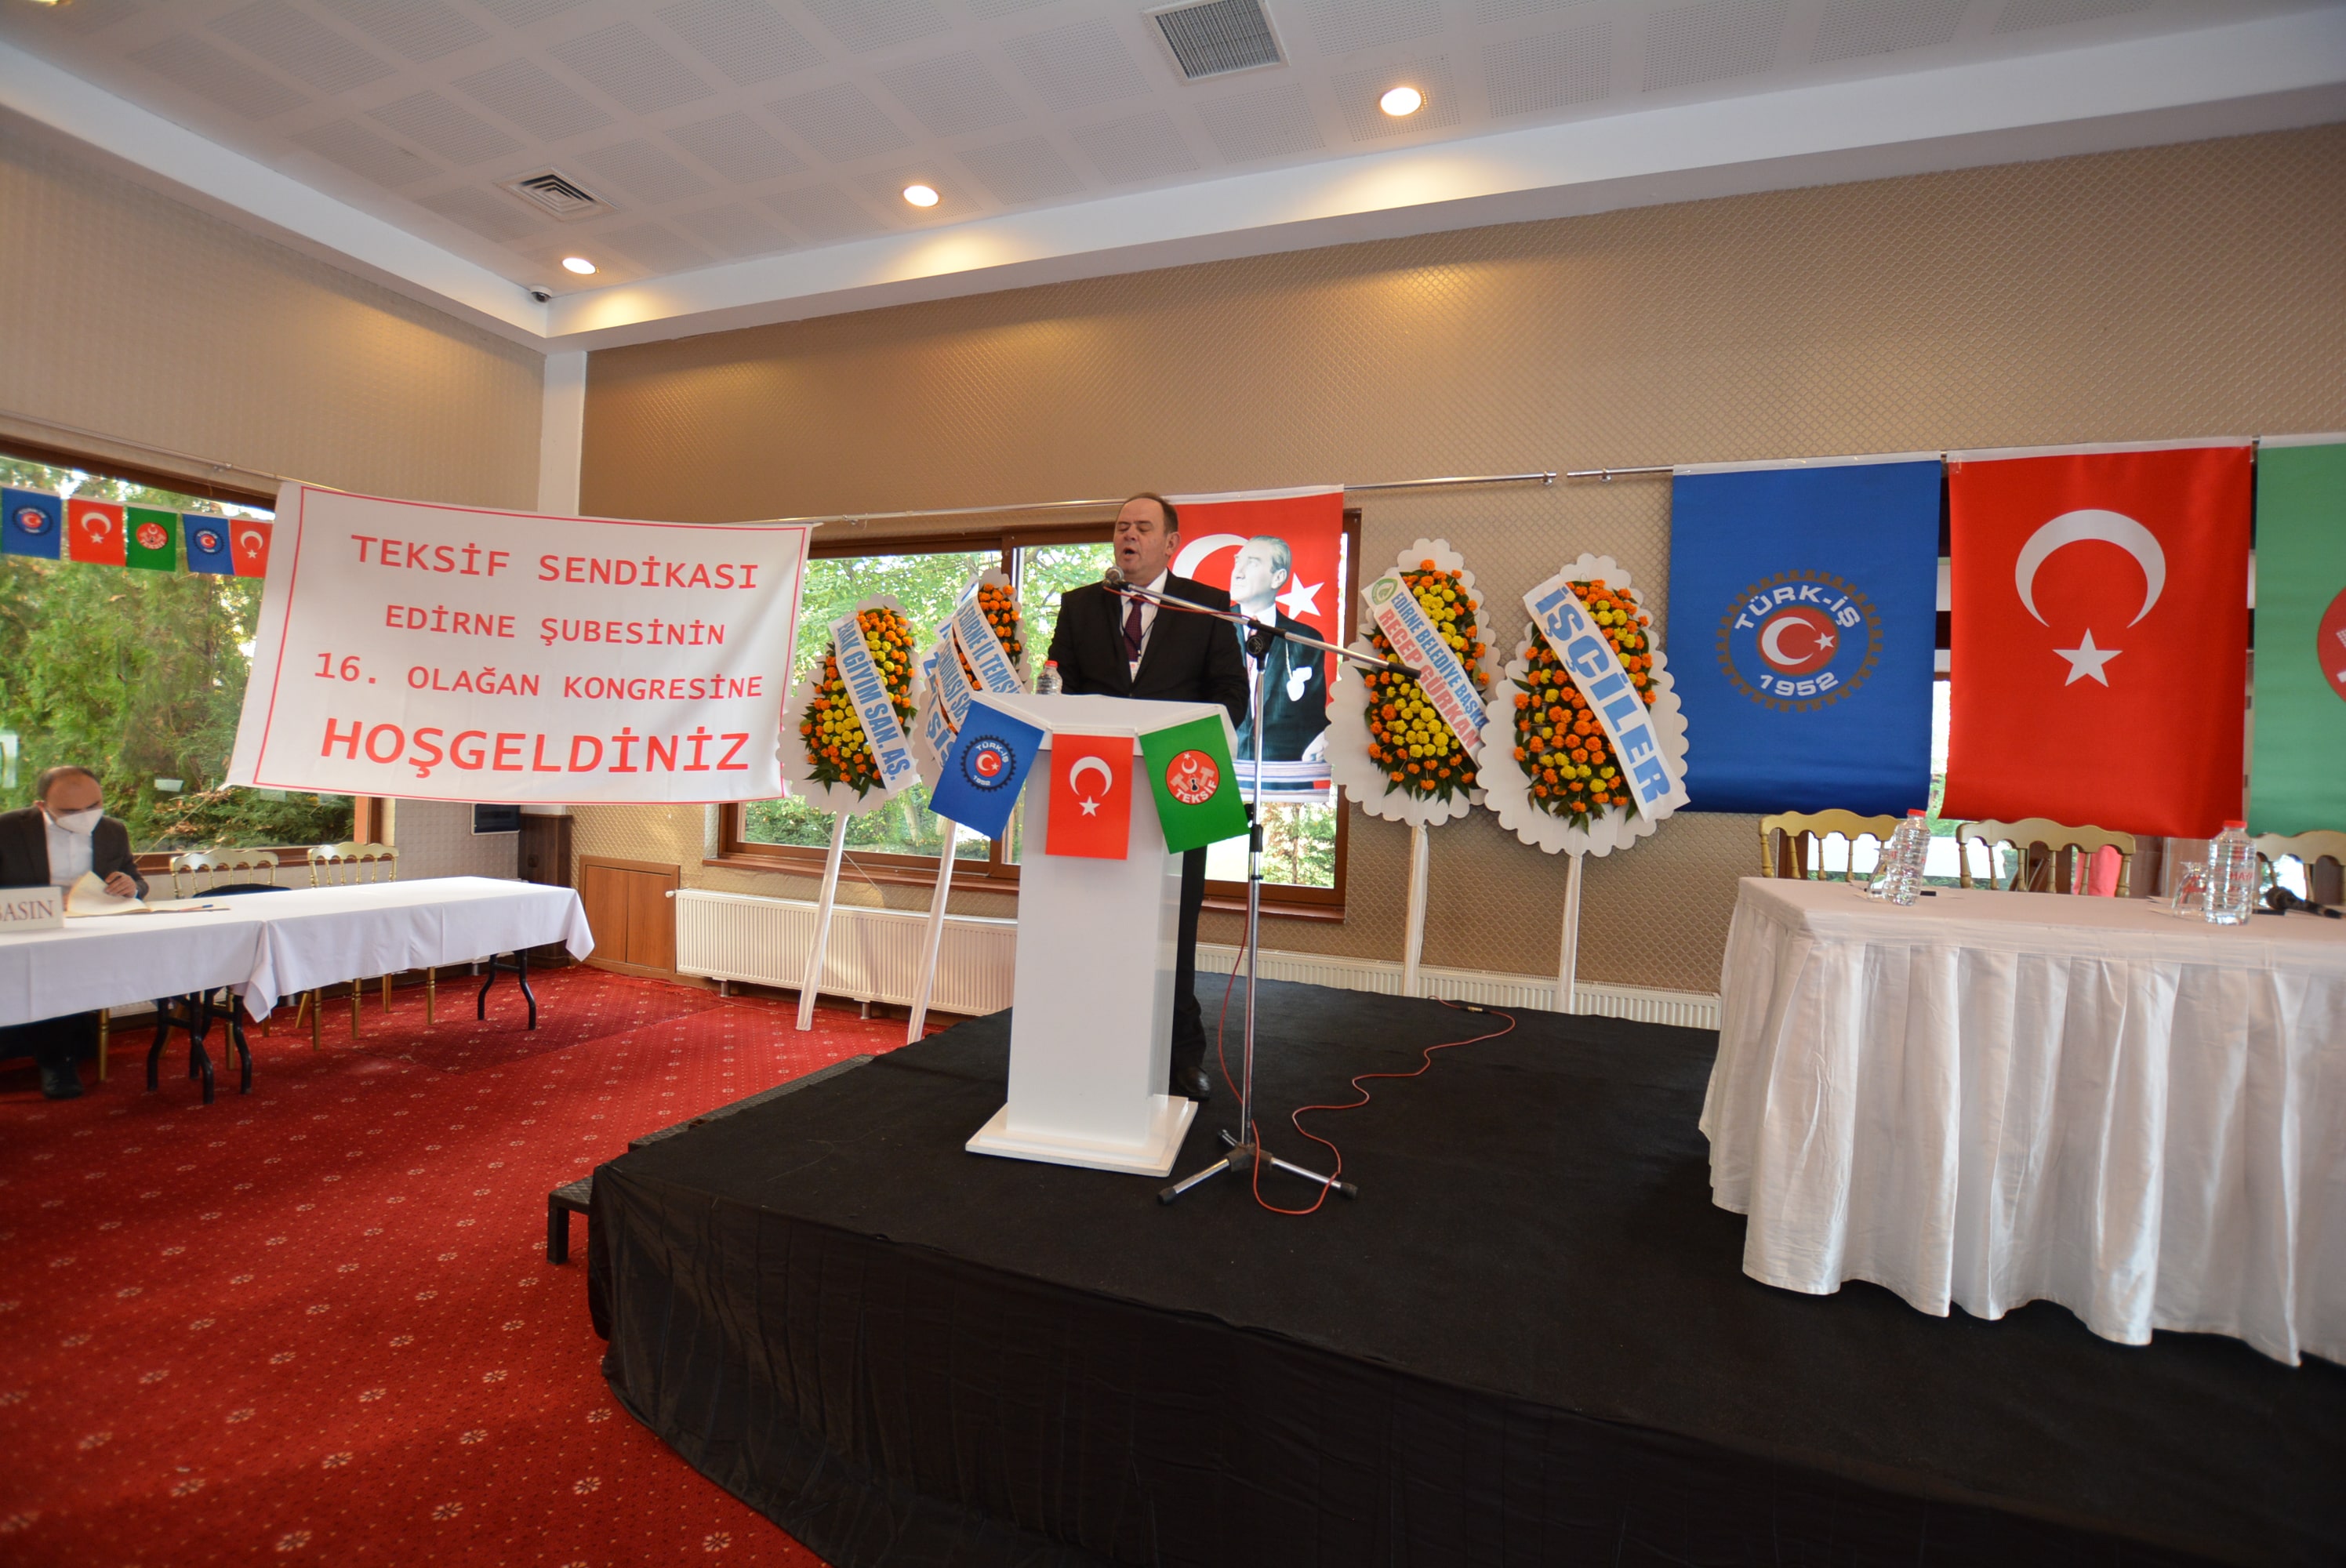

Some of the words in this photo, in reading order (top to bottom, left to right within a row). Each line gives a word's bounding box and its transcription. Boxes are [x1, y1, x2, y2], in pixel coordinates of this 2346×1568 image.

[350, 534, 510, 577] TEKSİF
[538, 554, 758, 589] SENDİKASI
[386, 604, 516, 638] EDİRNE
[540, 618, 724, 646] ŞUBESİNİN
[958, 604, 989, 650] EDİRNE
[1734, 585, 1861, 630] TÜRK-İŞ
[972, 640, 997, 662] İL
[980, 653, 1022, 694] TEMSİ
[1390, 592, 1425, 633] EDİRNE
[1415, 629, 1463, 688] BELEDİYE
[1454, 684, 1489, 730] BAŞKA
[314, 652, 376, 684] 16.
[407, 666, 539, 696] OLAĞAN
[564, 673, 763, 700] KONGRESİNE
[842, 650, 883, 705] GİYİM
[1378, 608, 1423, 664] RECEP
[1418, 665, 1482, 749] GÜRKAN
[1534, 586, 1671, 804] İŞÇİLER
[1760, 672, 1839, 696] 1952
[321, 717, 750, 779] HOŞGELDİNİZ
[864, 702, 899, 749] SAN.
[881, 747, 911, 781] AŞ.
